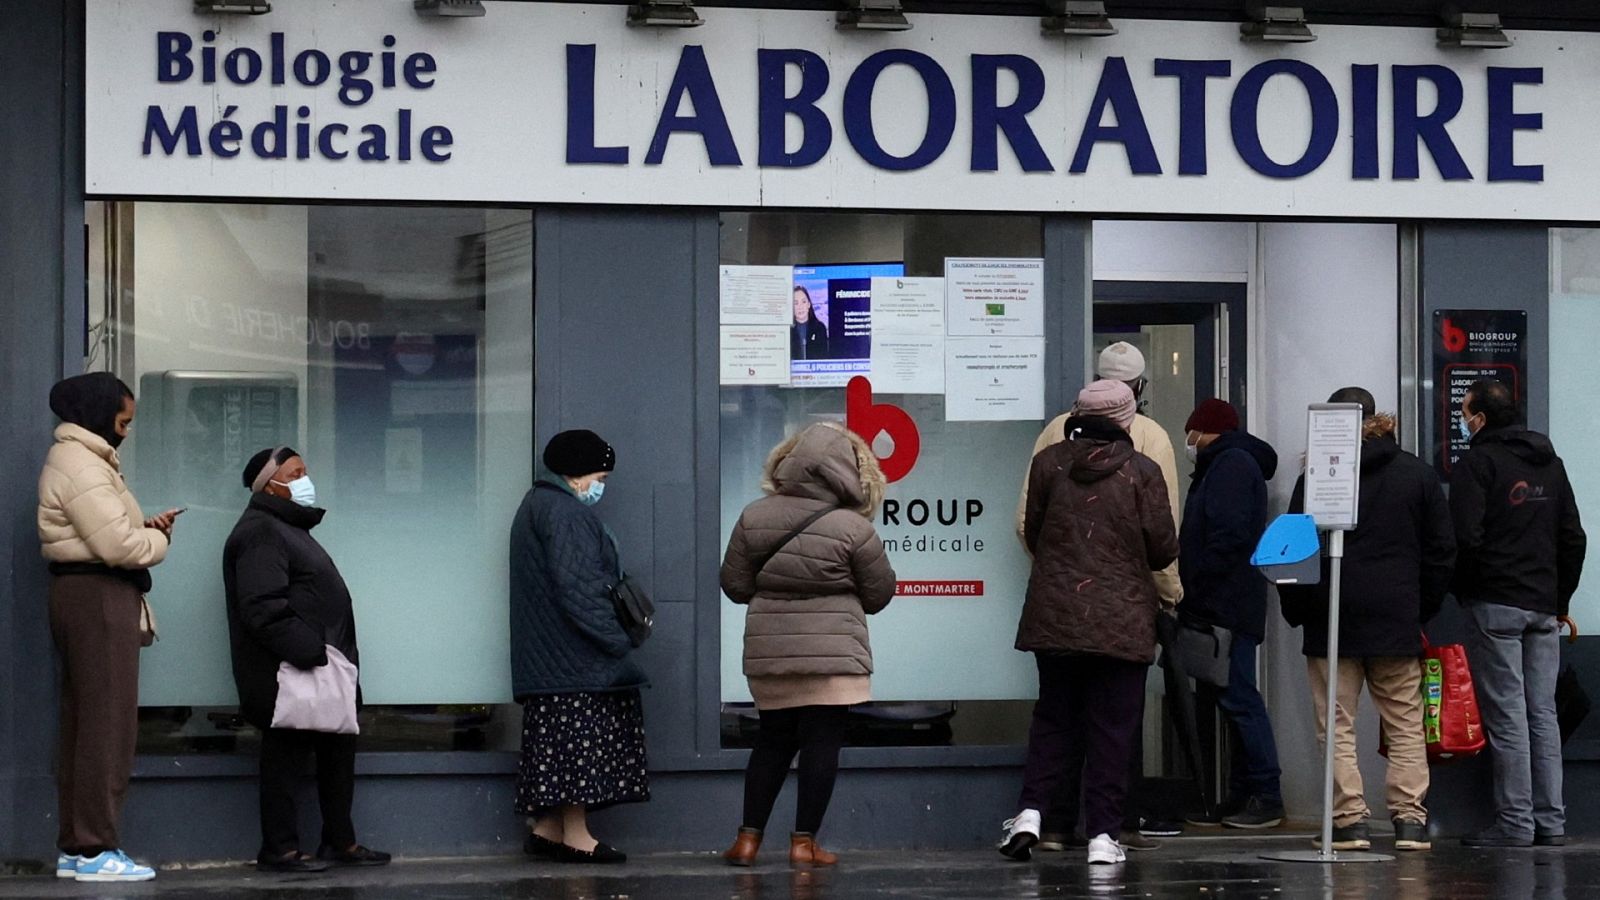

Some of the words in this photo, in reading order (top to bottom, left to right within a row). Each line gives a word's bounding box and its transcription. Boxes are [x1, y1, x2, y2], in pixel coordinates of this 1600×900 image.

[157, 30, 437, 106] Biologie
[566, 43, 1544, 182] LABORATOIRE
[142, 105, 454, 161] Médicale
[1469, 332, 1517, 341] BIOGROUP
[883, 499, 984, 526] ROUP
[883, 534, 984, 552] médicale
[904, 584, 976, 594] MONTMARTRE
